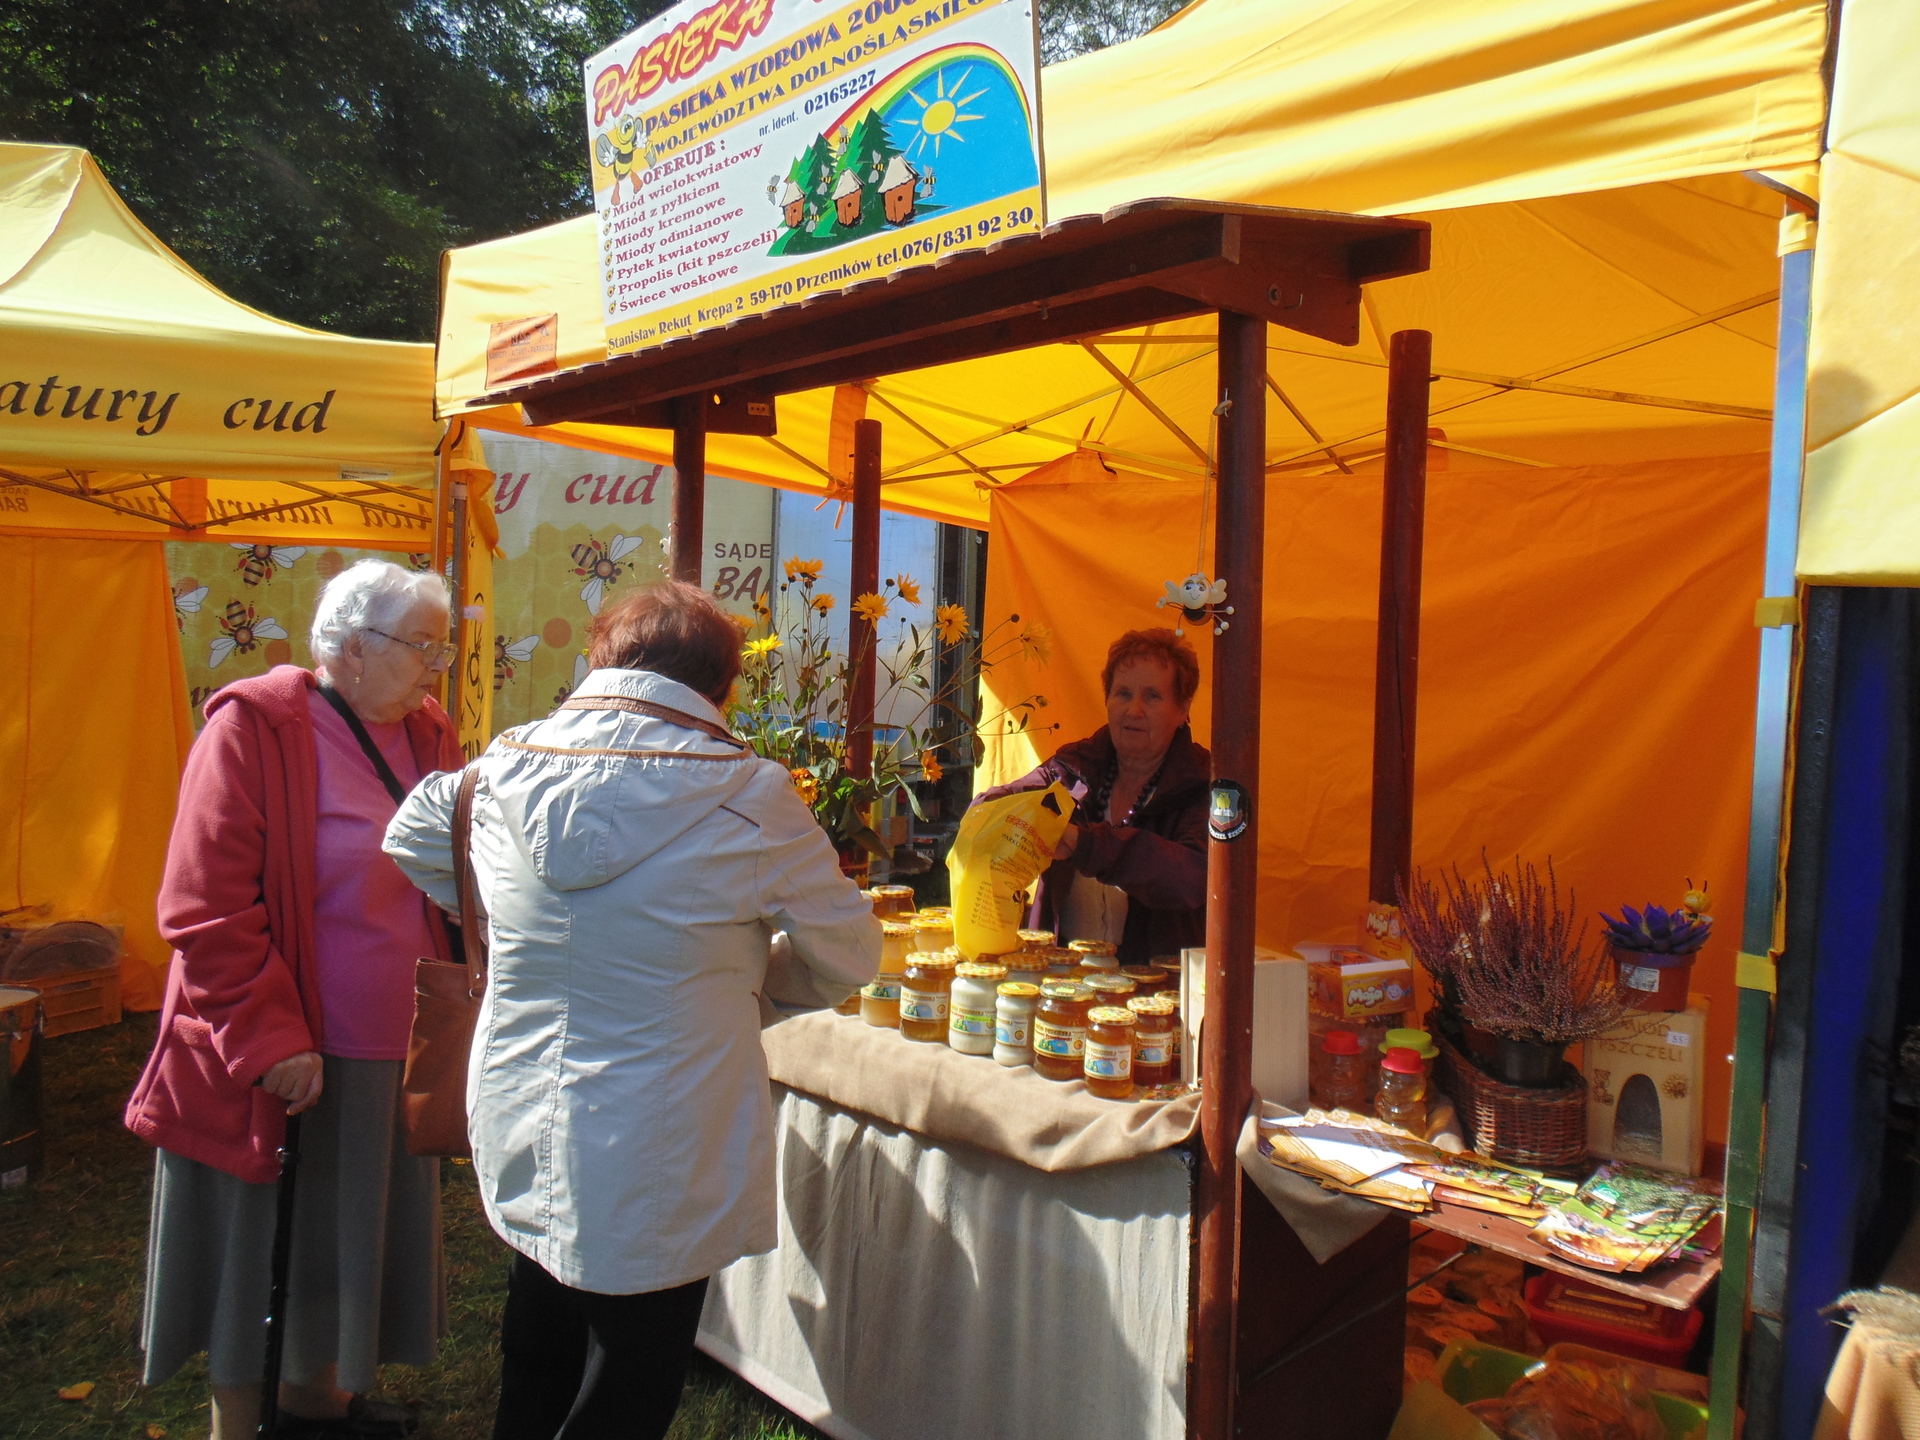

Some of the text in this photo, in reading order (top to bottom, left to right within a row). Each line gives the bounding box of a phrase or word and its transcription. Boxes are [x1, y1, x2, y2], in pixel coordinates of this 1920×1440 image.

[594, 0, 776, 126] PASIEKA
[645, 80, 727, 137] PASIEKA
[730, 21, 841, 92] WZOROWA
[654, 83, 785, 157] WOJEWÓDZTWA
[759, 69, 876, 137] nr. ident. 02165227
[612, 143, 763, 218] Miód wielokwiatowy
[613, 181, 721, 233] Miód z pyłkiem
[614, 196, 727, 249] Miody kremowe
[615, 207, 745, 265] Miody odmianowe
[608, 326, 657, 350] Stanisław
[658, 313, 692, 335] Rekut
[697, 303, 734, 324] Krępa
[735, 296, 744, 310] 2
[750, 281, 793, 307] 59-170
[796, 258, 873, 292] Przemków
[977, 215, 1001, 236] 92
[1006, 206, 1034, 229] 30
[616, 229, 730, 280] Pyłek kwiatowy
[617, 229, 778, 295] Propolis (kit pszczeli)
[619, 264, 739, 312] Świece woskowe
[222, 388, 337, 434] cud
[564, 465, 665, 505] cud
